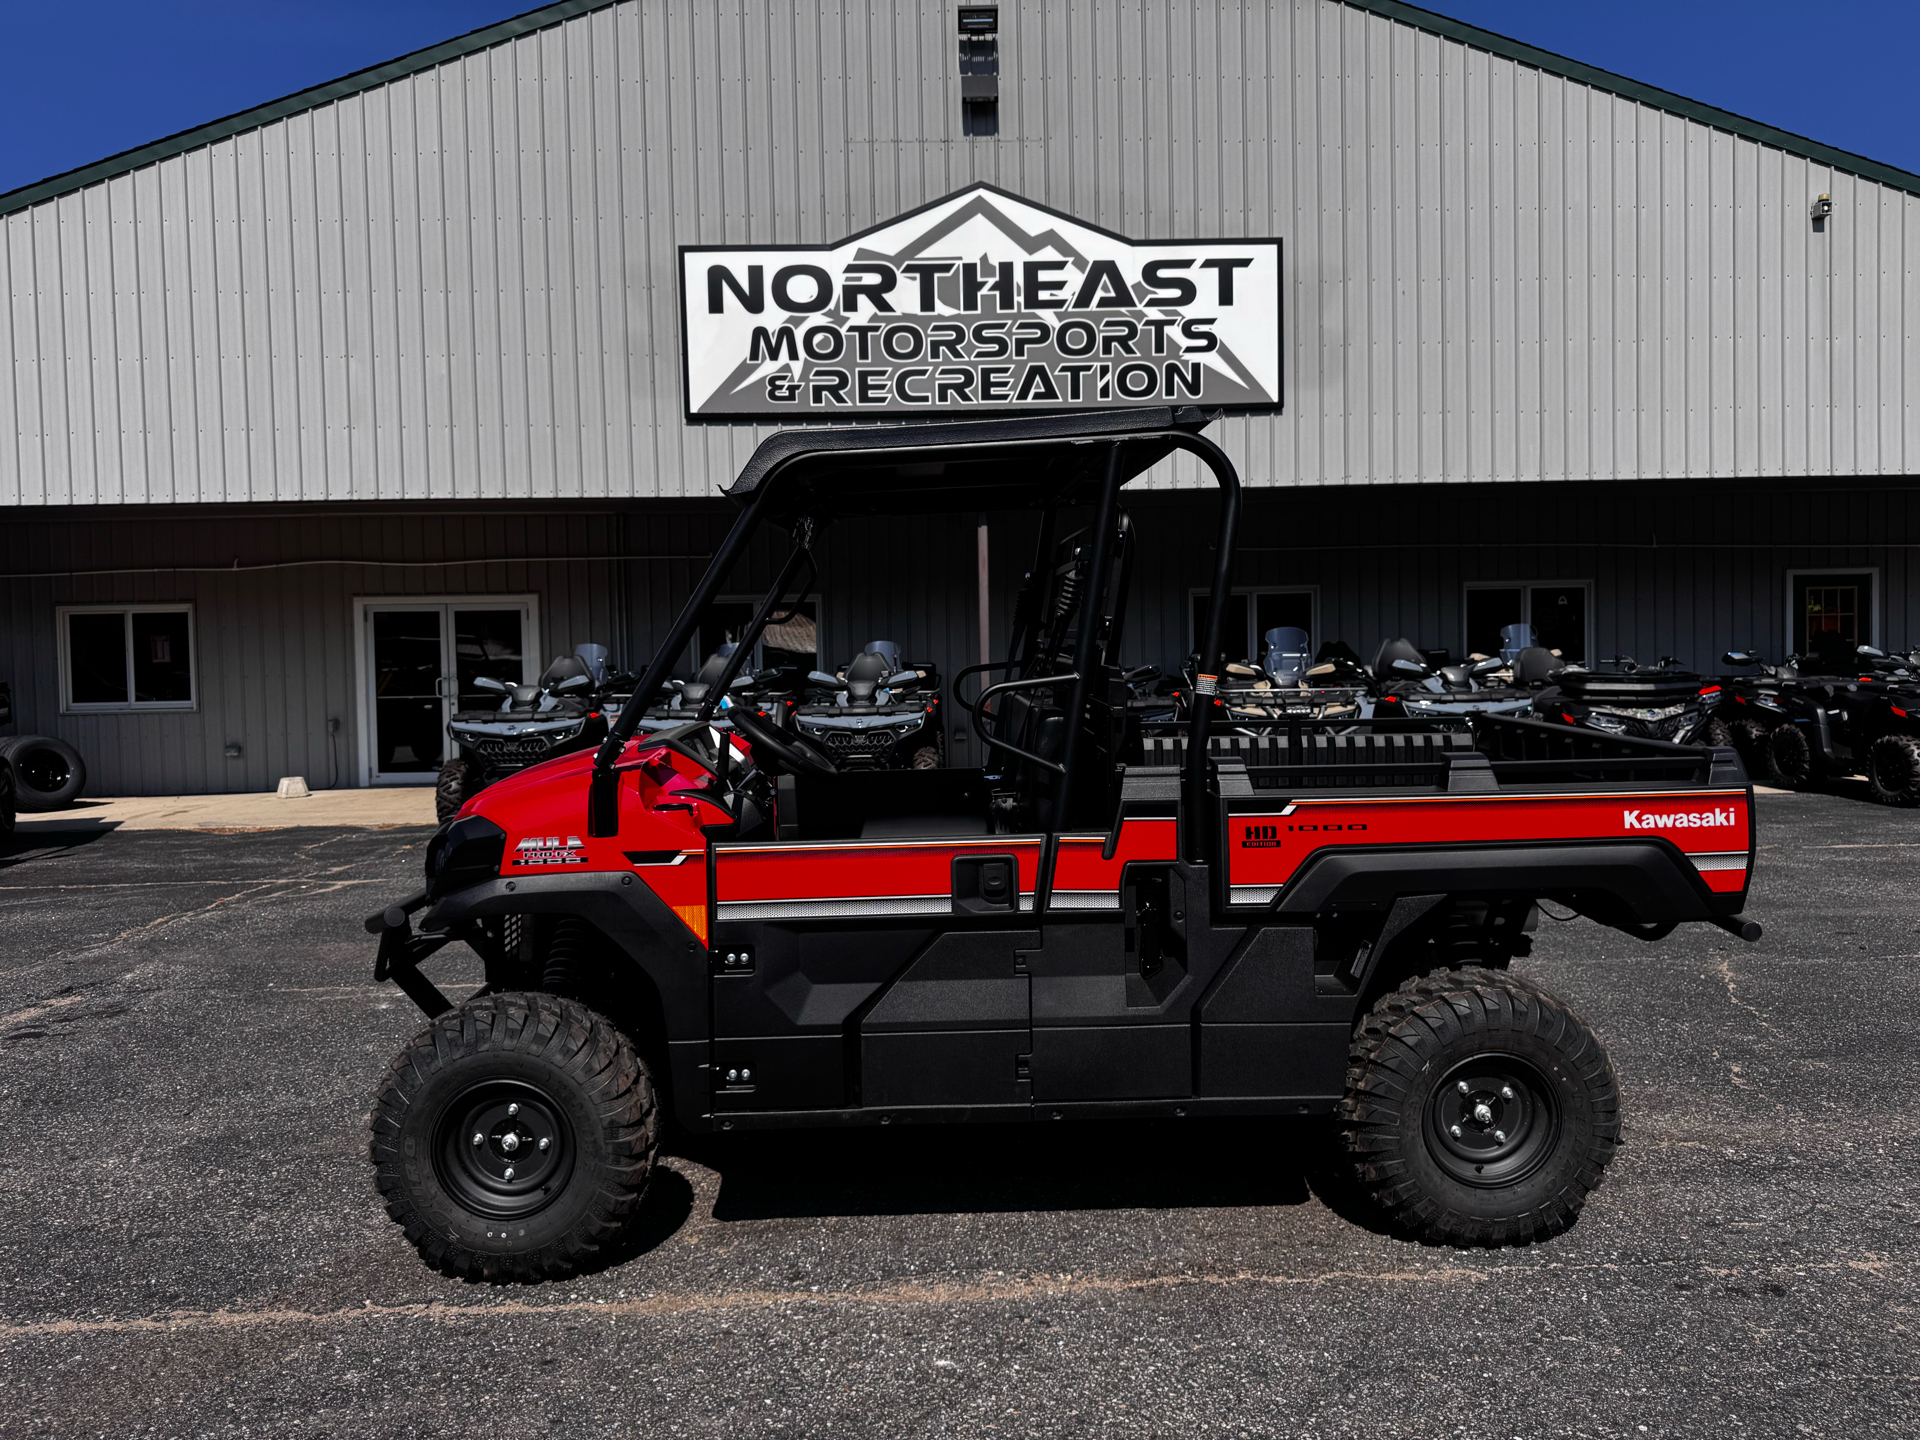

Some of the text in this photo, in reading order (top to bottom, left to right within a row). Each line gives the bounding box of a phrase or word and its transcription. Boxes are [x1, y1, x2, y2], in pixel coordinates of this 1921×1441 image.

[707, 257, 1254, 315] NORTHEAST
[748, 316, 1218, 362] MOTORSPORTS
[1287, 824, 1368, 832] 1000
[1623, 807, 1736, 829] Kawasaki
[1245, 825, 1277, 840] HD
[515, 836, 585, 852] MULE
[404, 1135, 453, 1227] DURO
